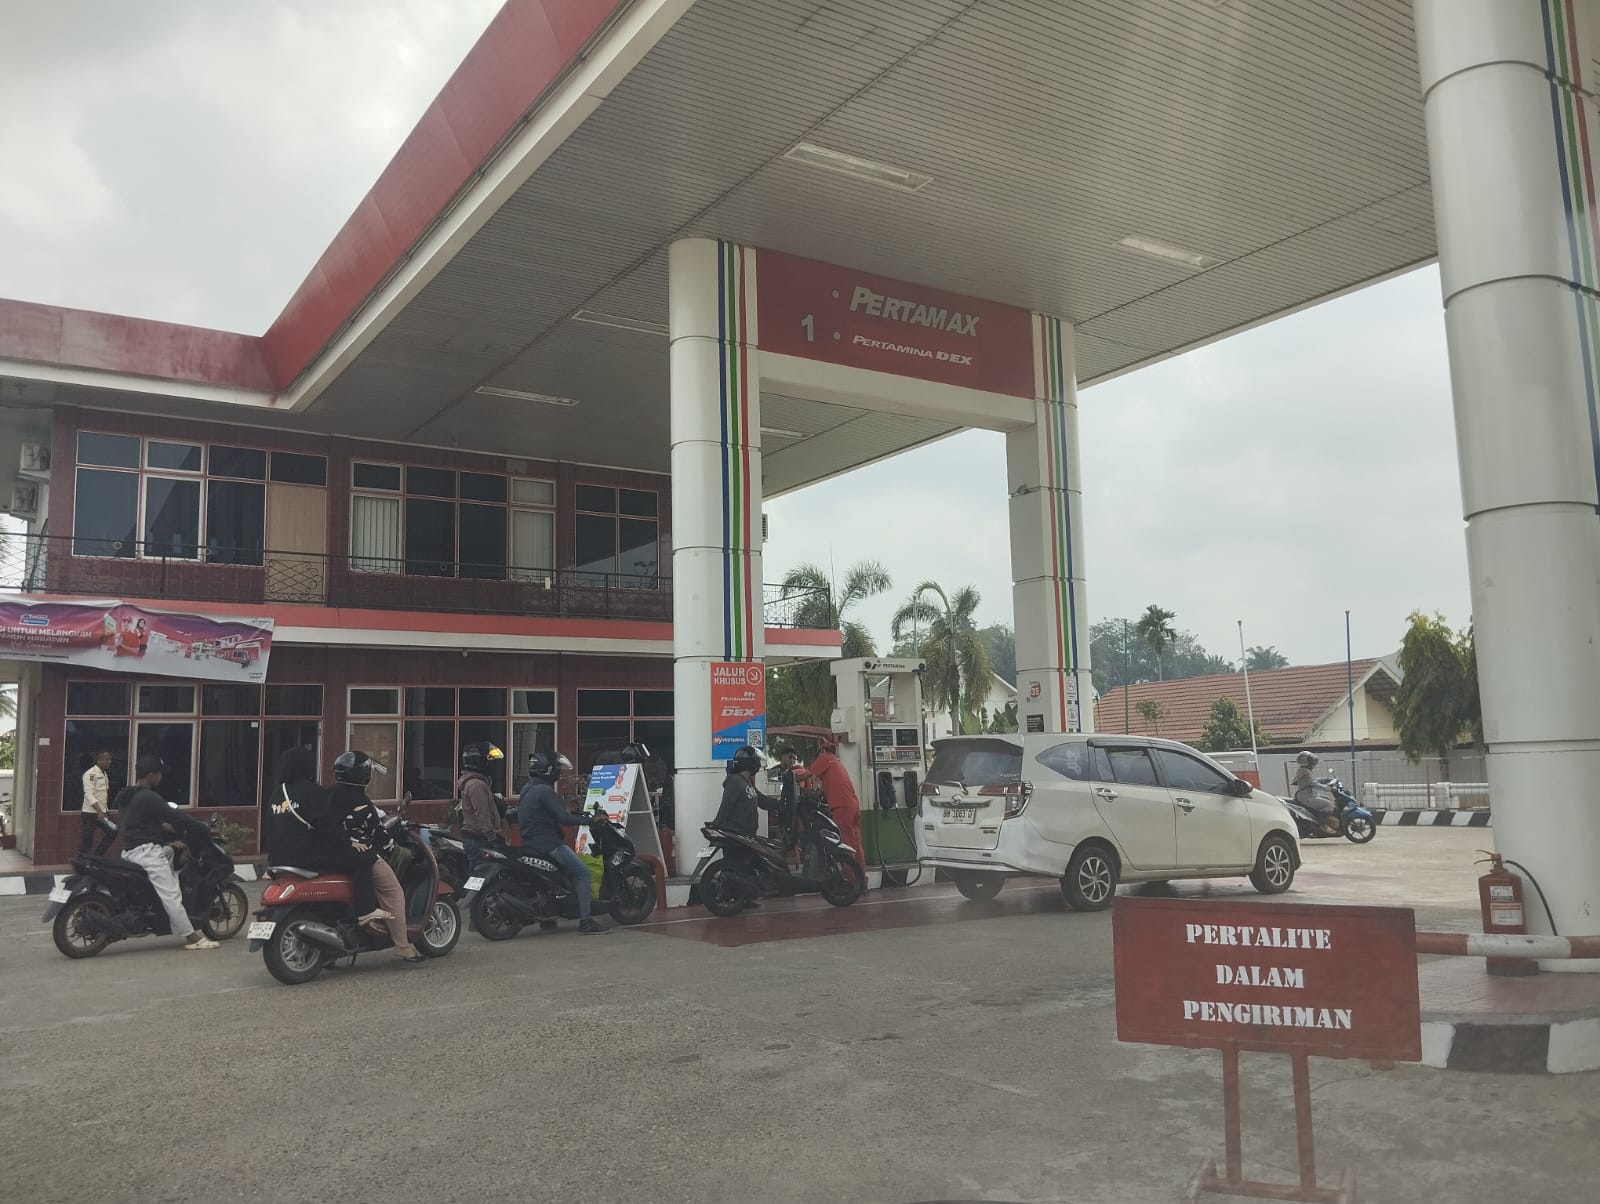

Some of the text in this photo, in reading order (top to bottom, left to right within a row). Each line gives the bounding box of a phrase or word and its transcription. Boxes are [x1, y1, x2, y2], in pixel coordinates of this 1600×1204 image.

[850, 286, 980, 337] PERTAMAX
[801, 314, 815, 341] 1
[853, 335, 974, 366] PERTAMINA DEX
[7, 626, 38, 635] UNTUK
[713, 667, 745, 677] JALUR
[713, 677, 746, 686] KHUSUS
[721, 708, 755, 717] DEX
[1185, 923, 1332, 950] PERTALITE
[1215, 964, 1305, 989] DALAM
[1183, 1000, 1352, 1030] PENGIRIMAN
